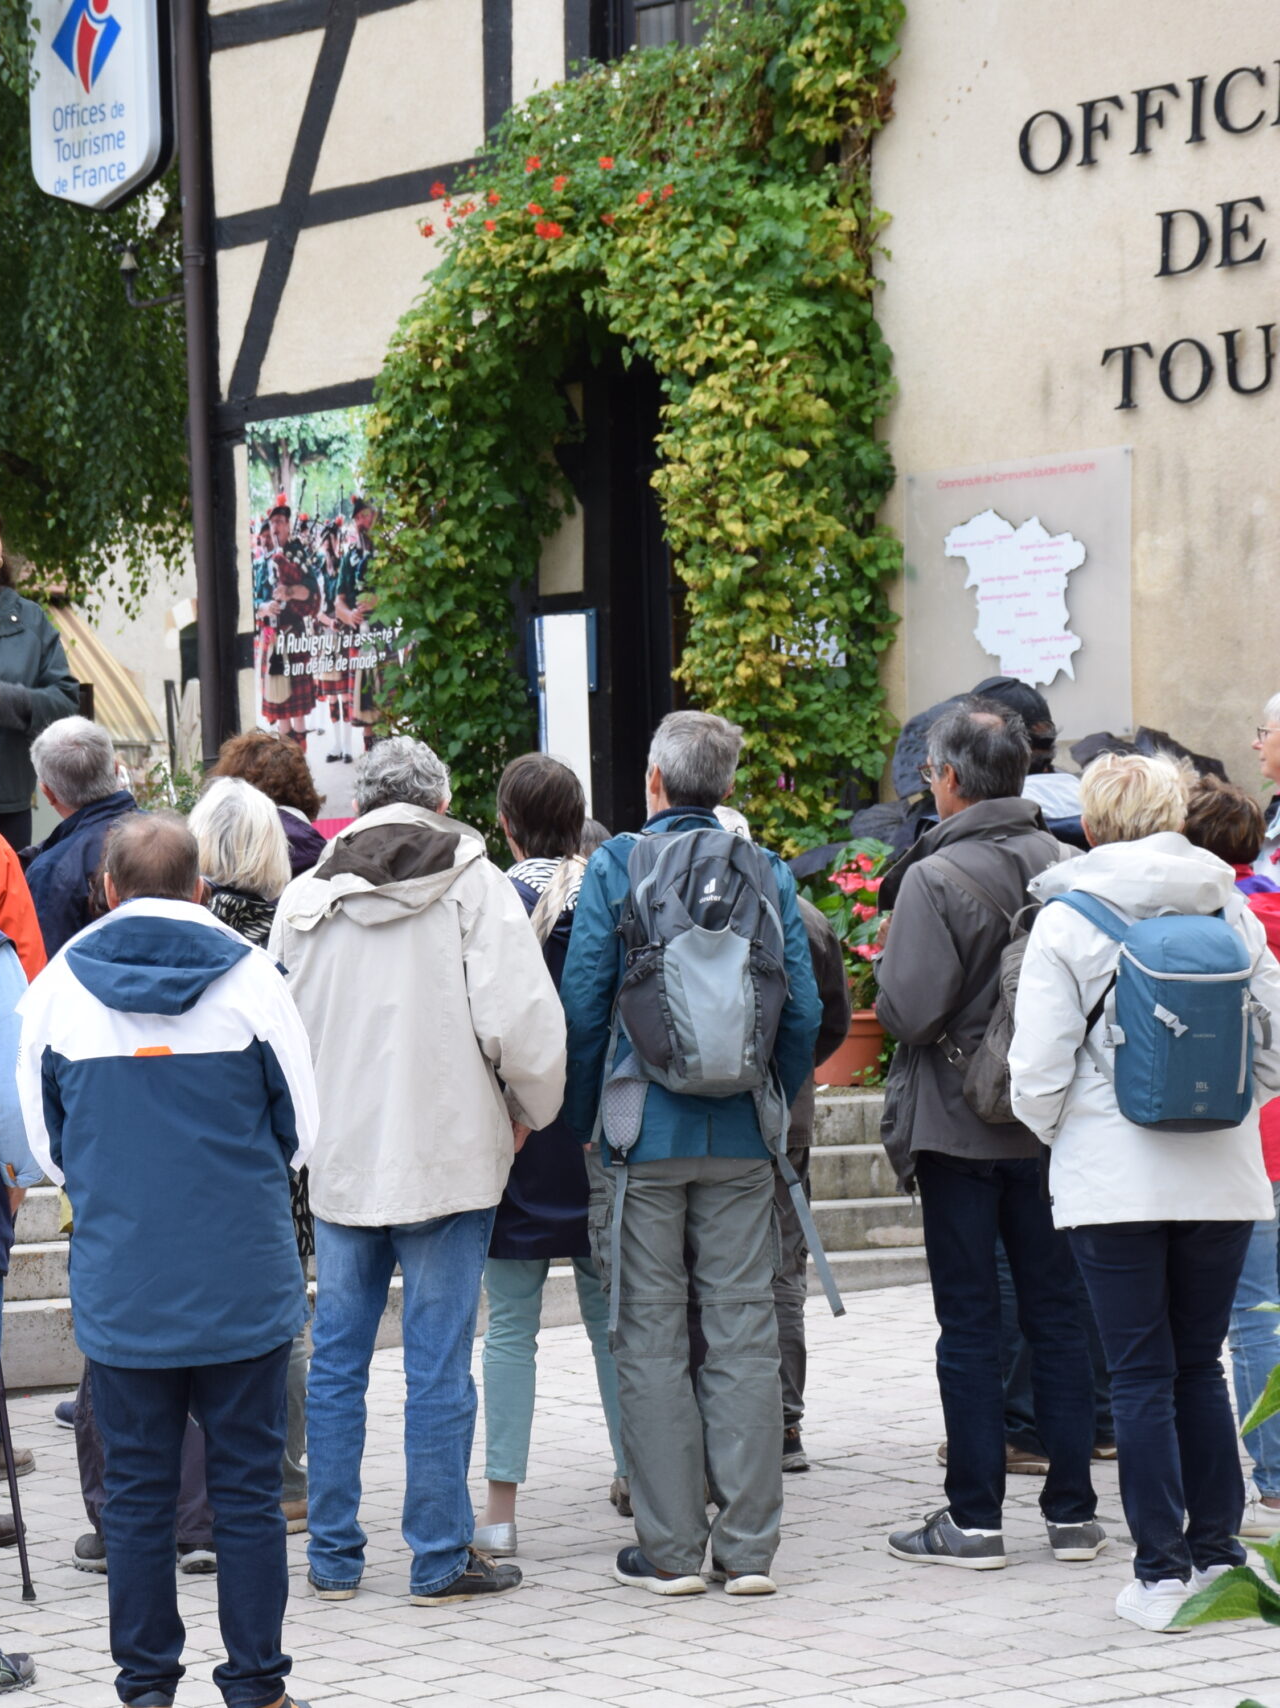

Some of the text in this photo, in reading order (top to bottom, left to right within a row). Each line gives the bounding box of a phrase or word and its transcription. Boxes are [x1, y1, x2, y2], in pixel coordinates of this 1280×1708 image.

[53, 101, 125, 132] Offices de
[54, 130, 126, 162] Tourisme
[54, 161, 126, 194] de France
[1154, 196, 1267, 278] DE
[1101, 323, 1277, 411] TOU
[277, 629, 284, 655] À
[286, 632, 335, 656] Aubigny,
[291, 662, 304, 676] un
[306, 655, 333, 675] défilé
[335, 654, 348, 671] de
